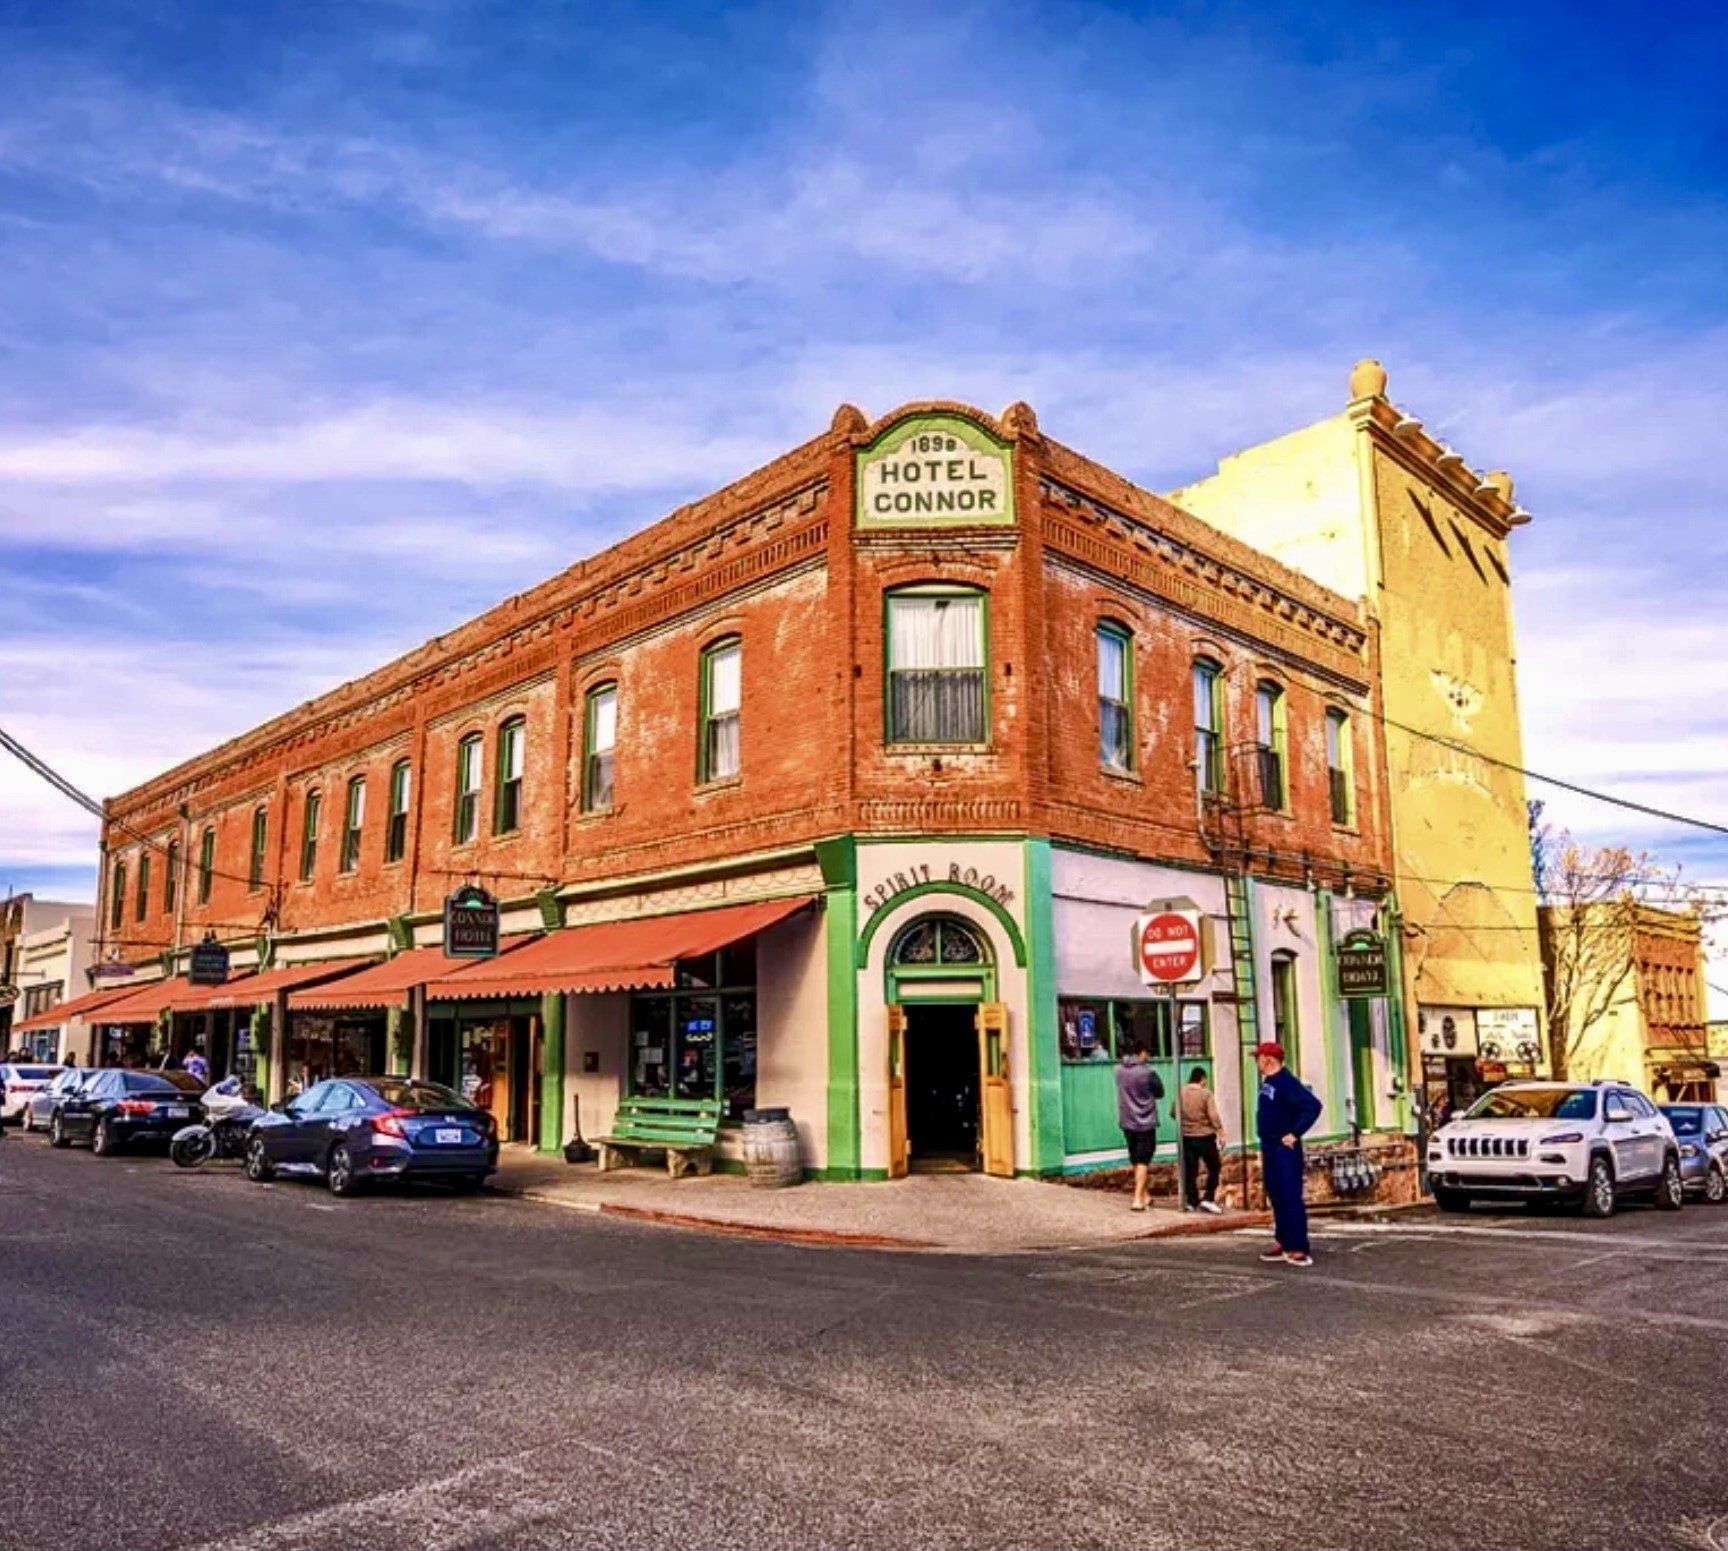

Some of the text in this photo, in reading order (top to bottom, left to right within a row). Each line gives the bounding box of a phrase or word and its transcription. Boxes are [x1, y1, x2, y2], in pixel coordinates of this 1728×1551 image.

[911, 435, 957, 453] 1898
[881, 460, 987, 483] HOTEL
[874, 489, 997, 513] CONNOR
[863, 862, 1015, 909] SPIRIT ROOM
[1147, 924, 1189, 939] DO NOT
[1152, 956, 1187, 968] ENTER
